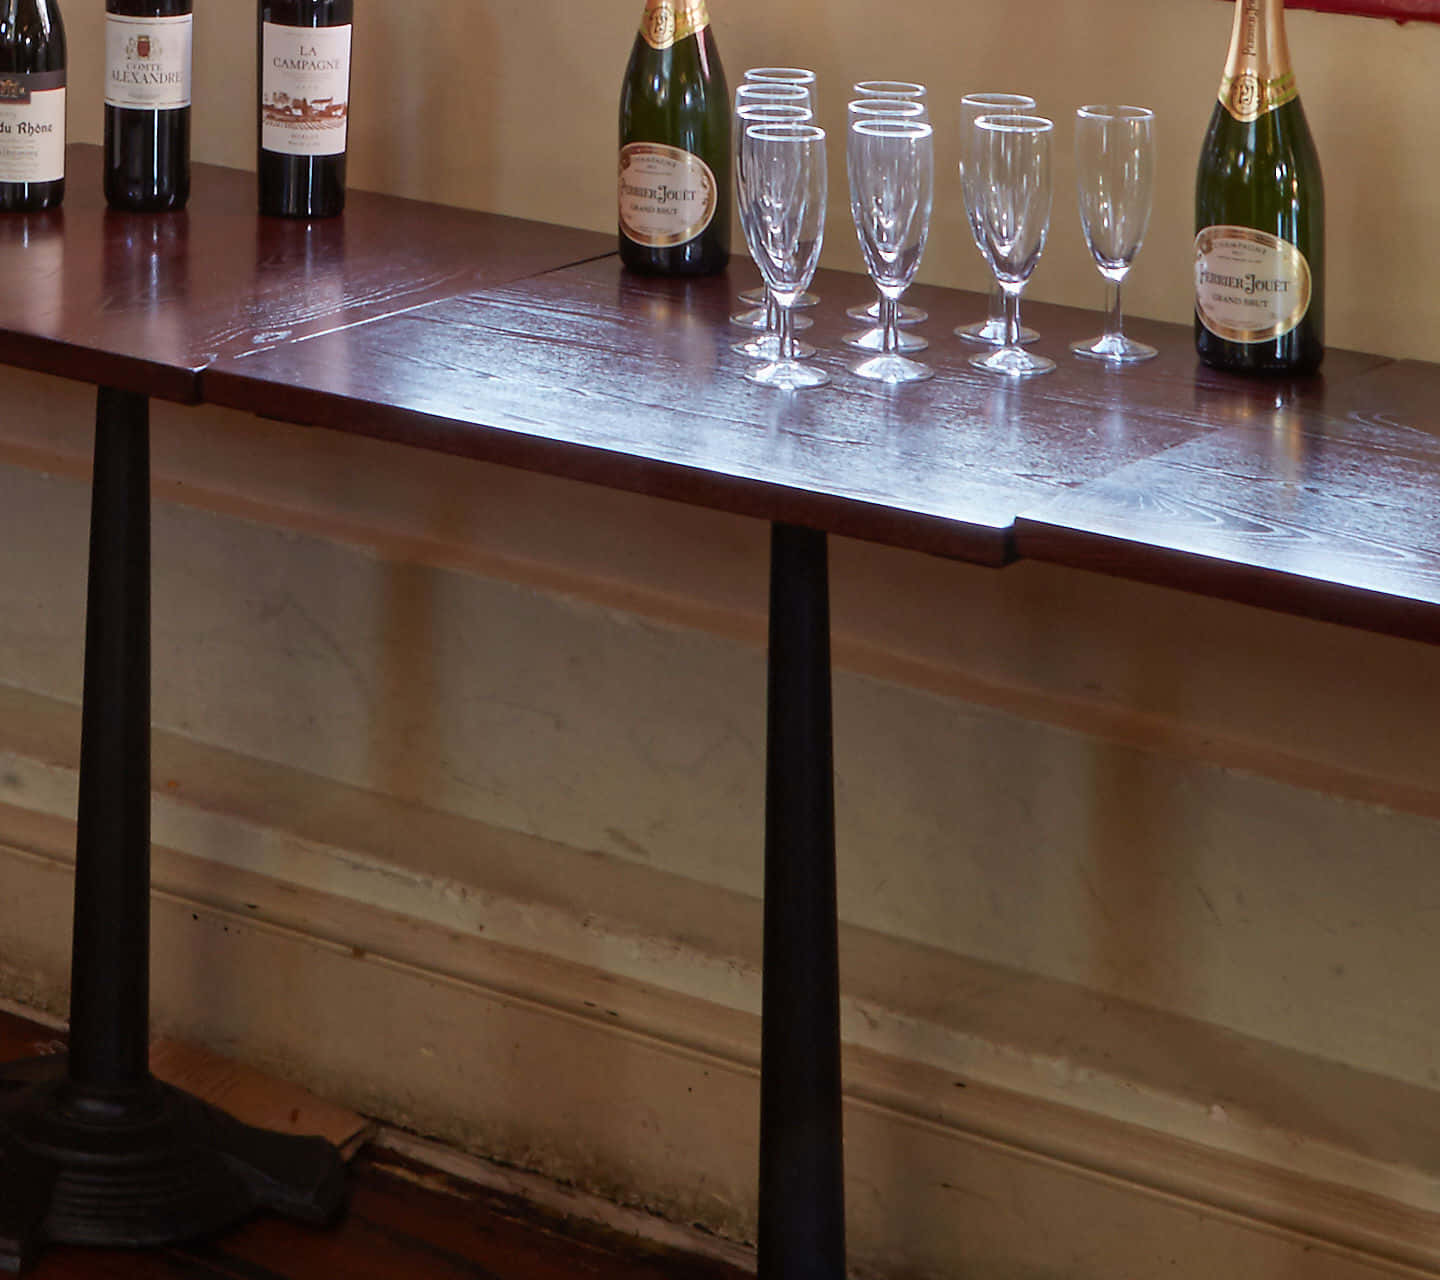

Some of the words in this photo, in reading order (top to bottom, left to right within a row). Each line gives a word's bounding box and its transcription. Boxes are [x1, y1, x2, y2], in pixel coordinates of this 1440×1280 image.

[299, 45, 318, 57] LA
[126, 63, 160, 72] COMTE
[272, 56, 340, 71] CAMPAGNE
[111, 69, 180, 85] ALEXANDRE
